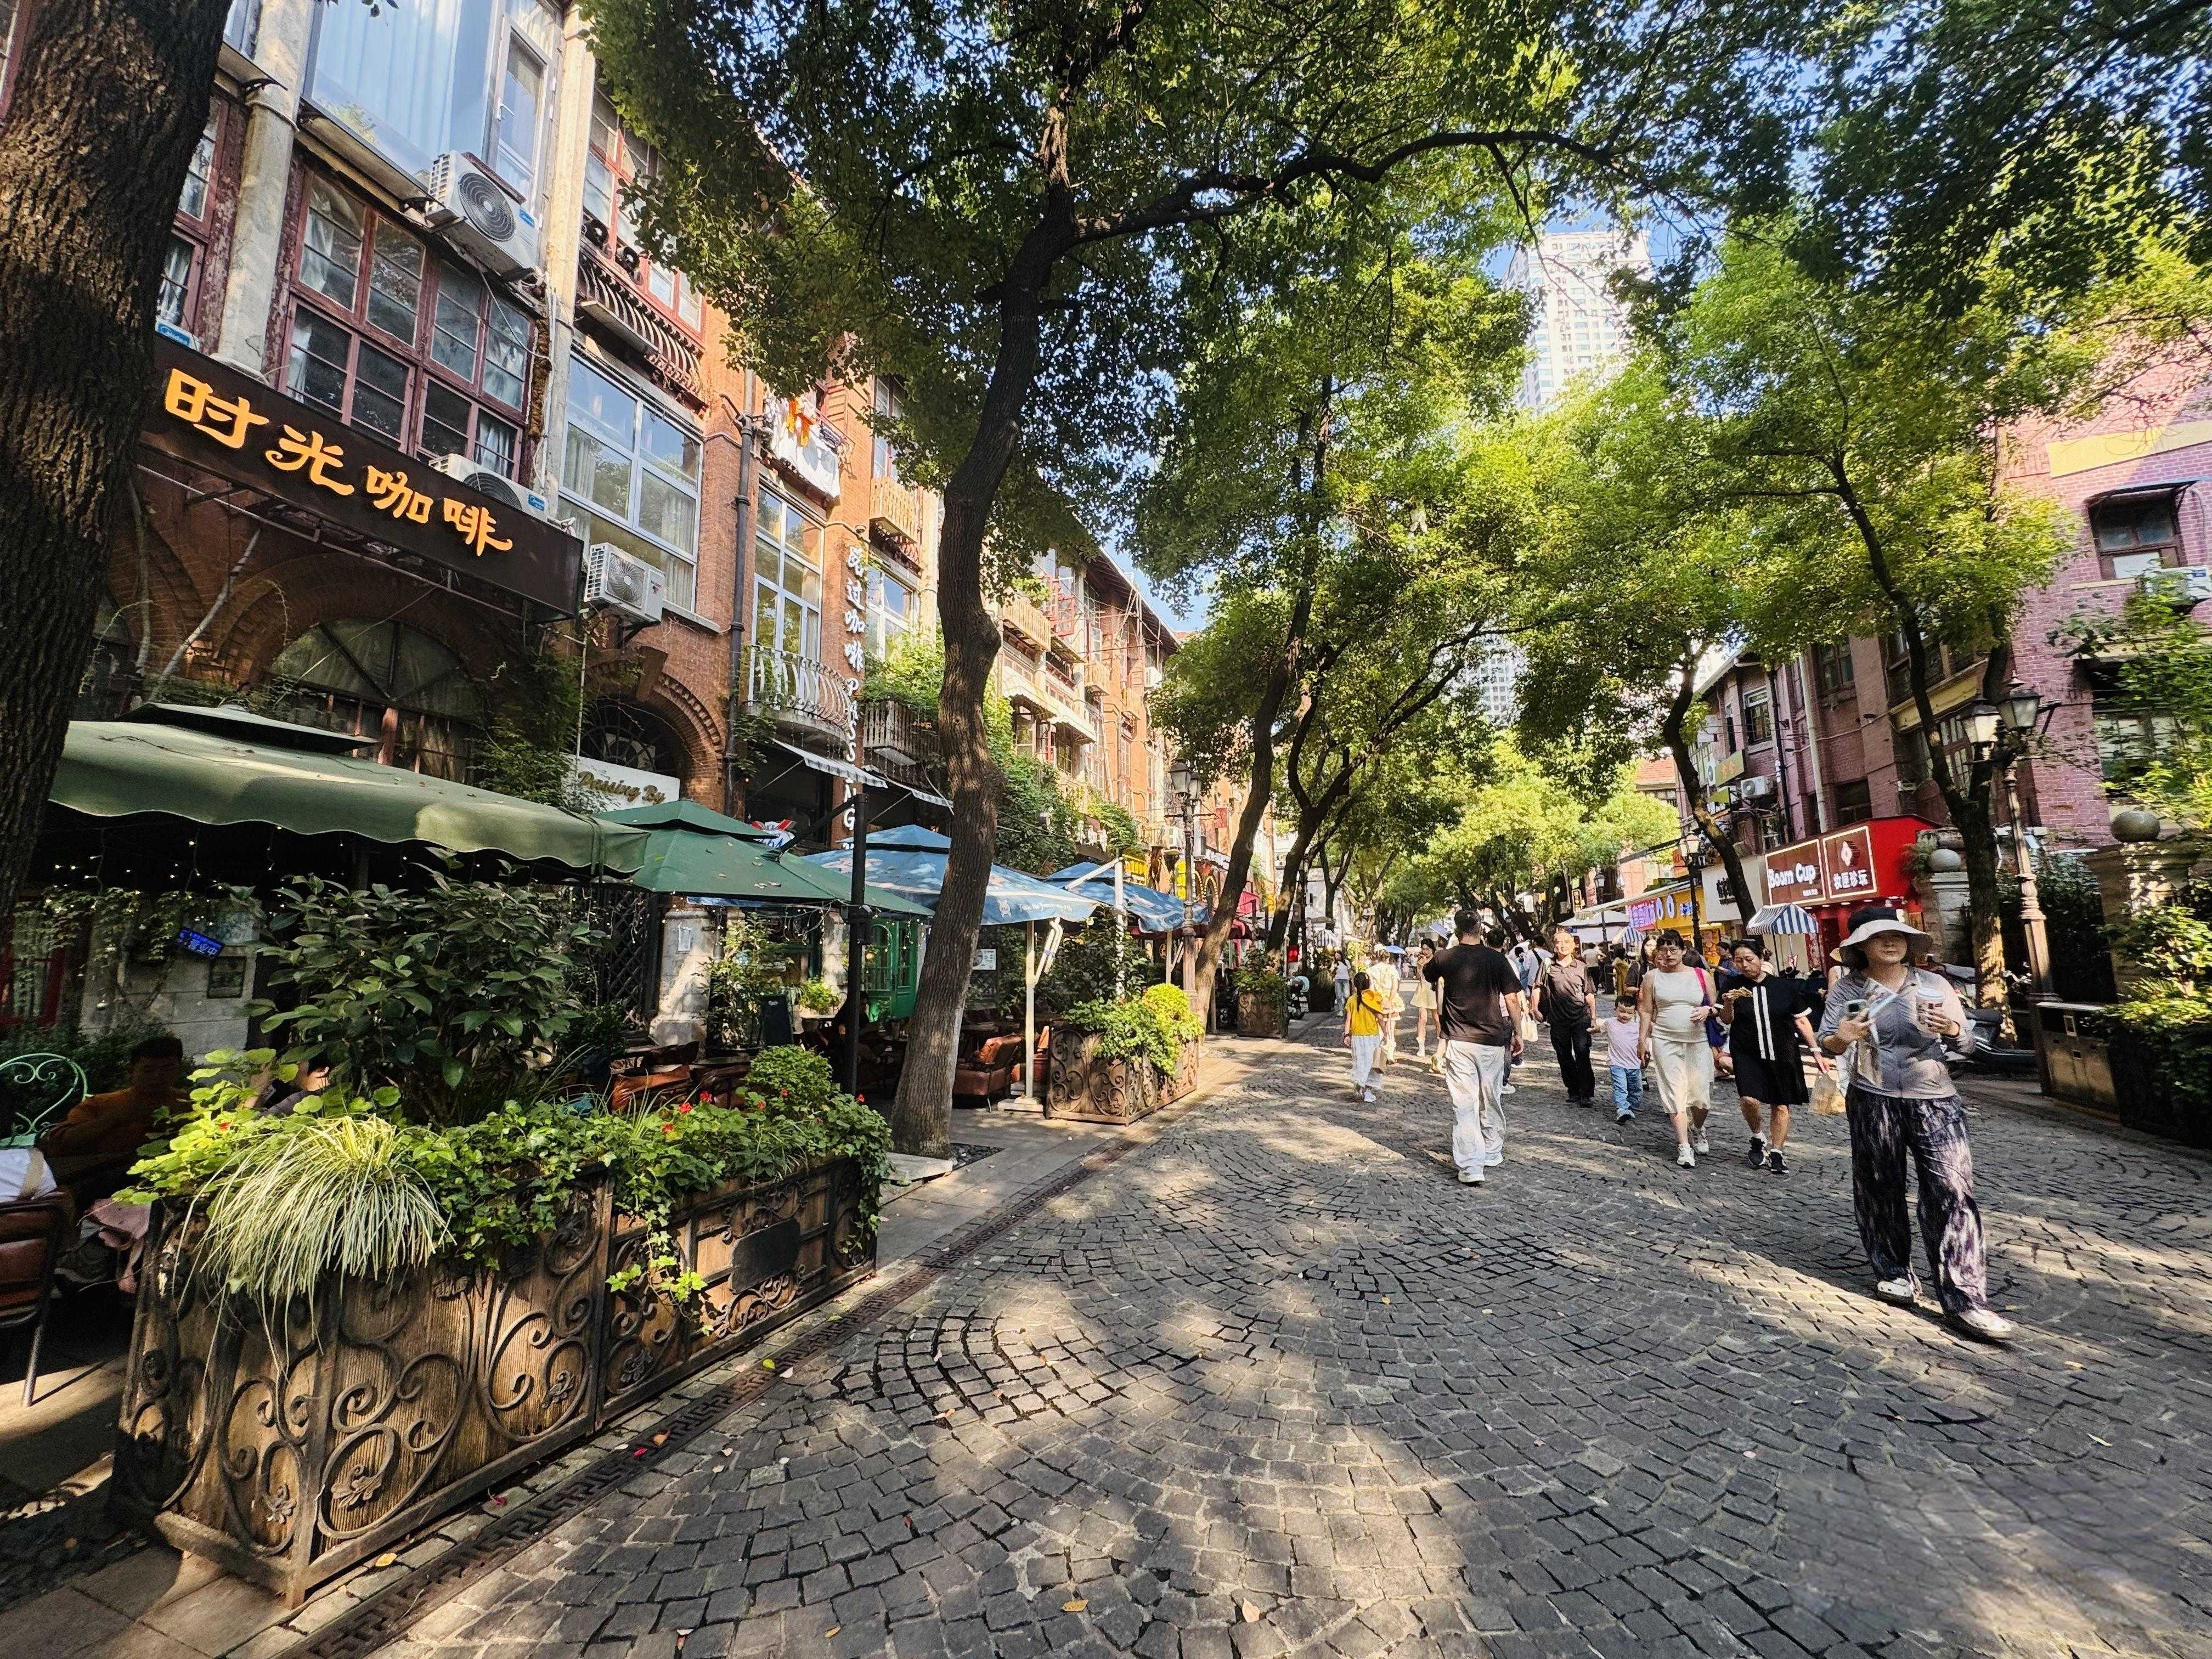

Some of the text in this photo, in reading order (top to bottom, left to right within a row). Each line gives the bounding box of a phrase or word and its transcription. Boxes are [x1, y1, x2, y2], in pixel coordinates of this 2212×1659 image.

[165, 368, 513, 556] 时光咖啡
[844, 546, 865, 673] 路过咖啡
[578, 771, 666, 805] Passing By
[844, 678, 859, 831] PASSNG
[1768, 863, 1816, 888] Boom Cup
[188, 939, 217, 956] 营业中
